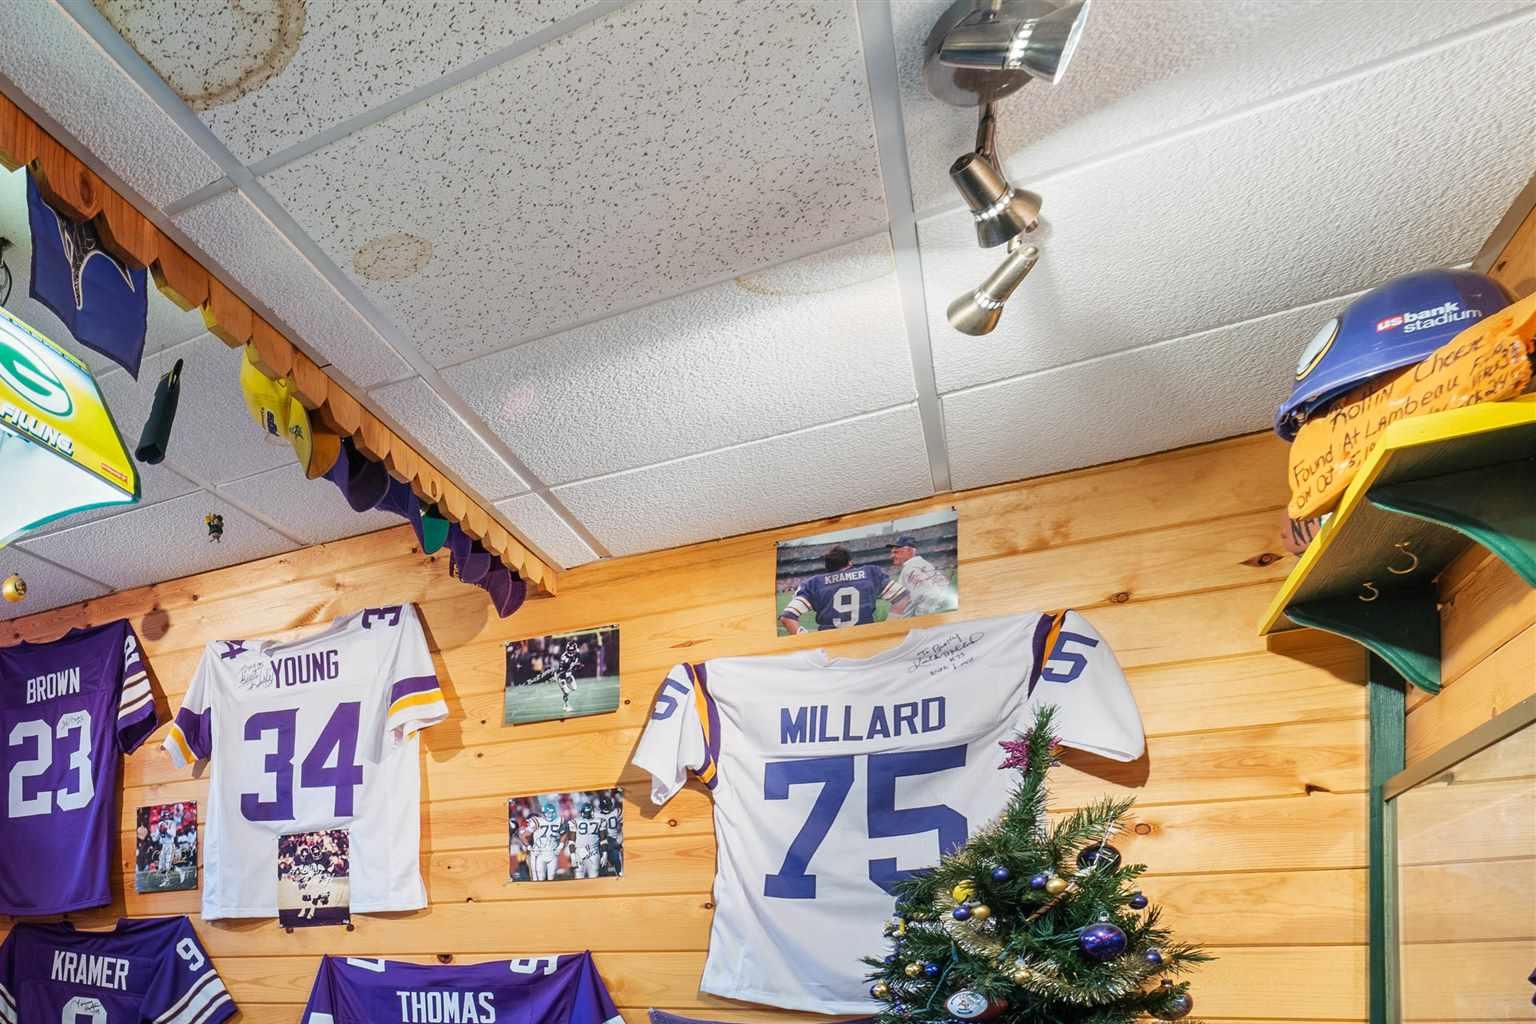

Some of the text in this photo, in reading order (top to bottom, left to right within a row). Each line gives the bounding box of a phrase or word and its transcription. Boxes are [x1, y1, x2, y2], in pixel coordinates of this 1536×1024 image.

[1403, 309, 1482, 333] stadium
[1293, 447, 1334, 485] Found
[824, 570, 866, 585] KRAMER
[832, 586, 860, 628] 9
[270, 649, 340, 689] YOUNG
[1042, 629, 1100, 684] 5
[26, 667, 81, 704] BROWN
[779, 696, 946, 746] MILLARD
[8, 709, 96, 819] 23
[240, 701, 364, 823] 34
[540, 825, 561, 839] 75
[578, 822, 600, 836] 97
[763, 742, 969, 902] 75
[51, 950, 130, 992] KRAMER
[176, 937, 206, 972] 9
[396, 990, 497, 1024] THOMAS
